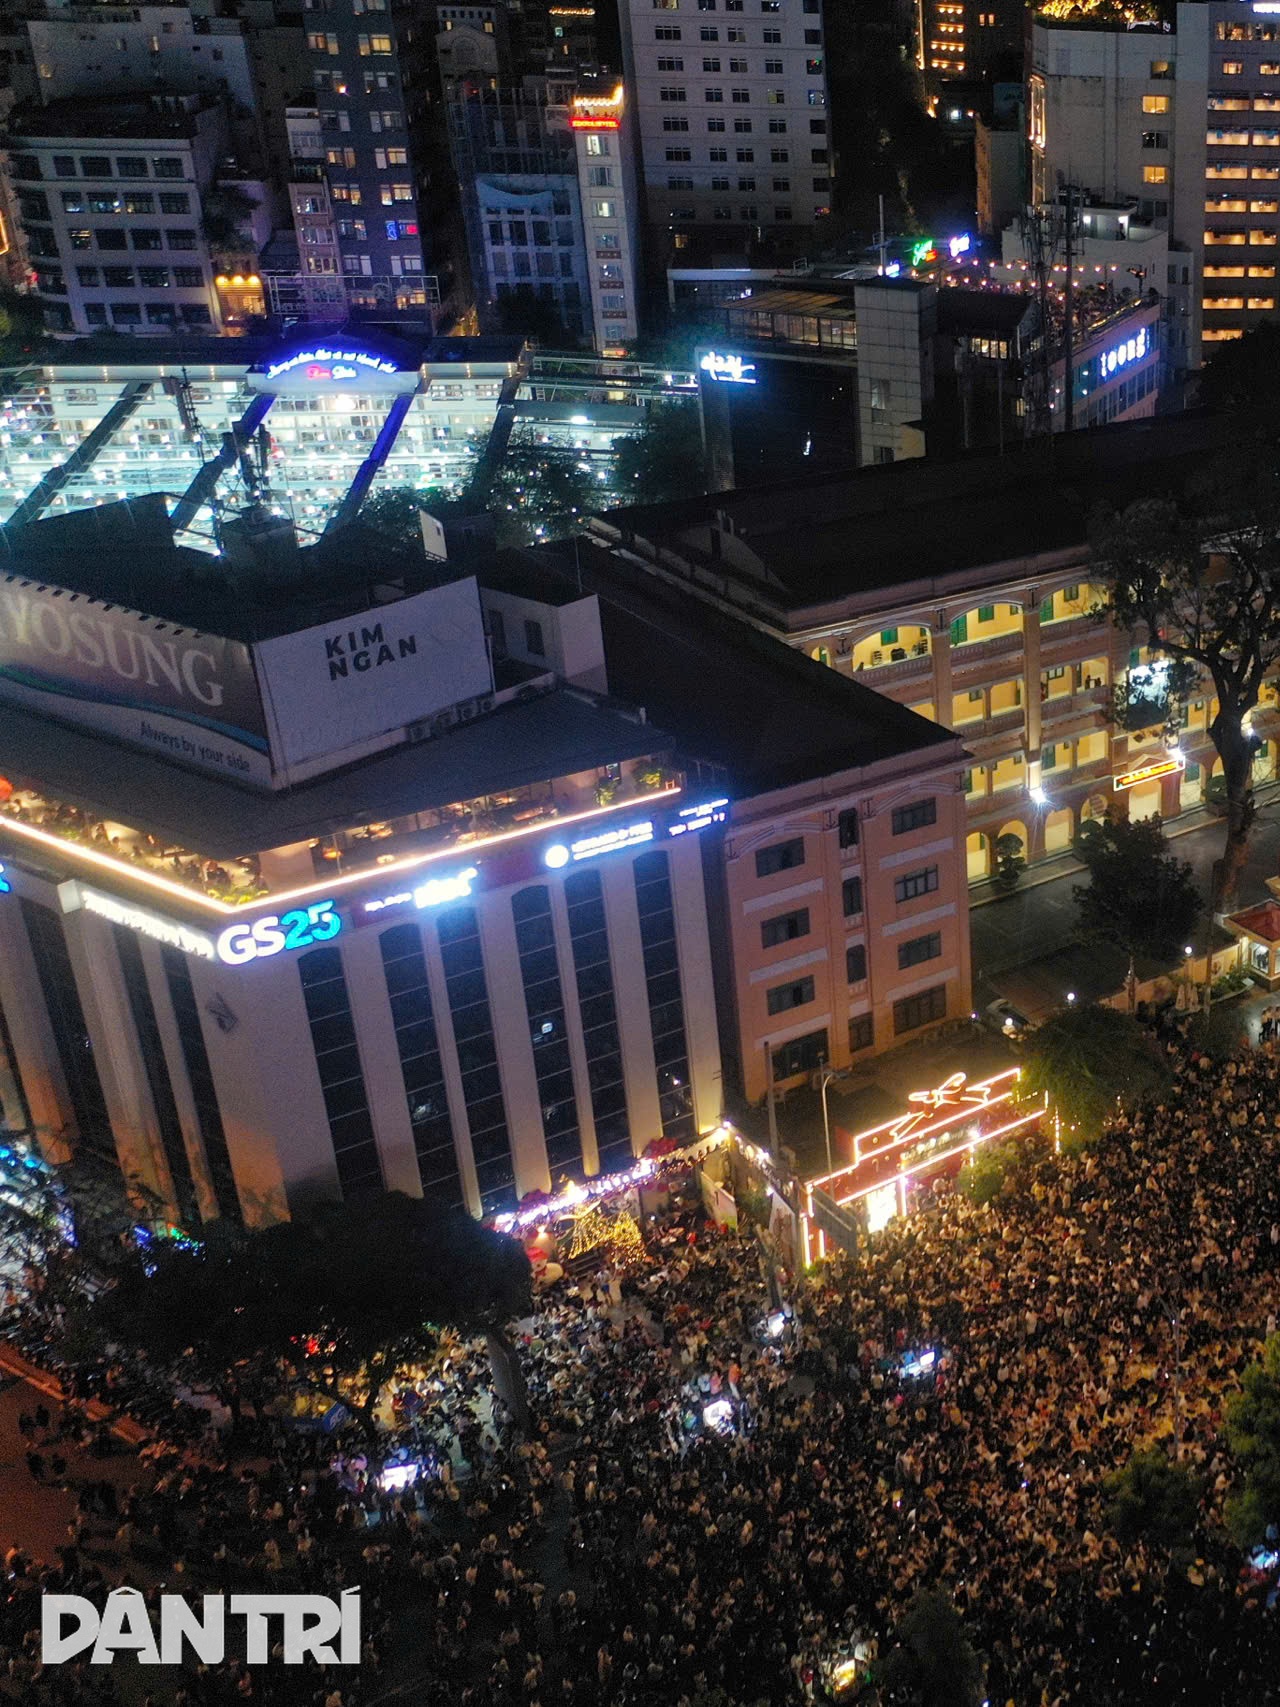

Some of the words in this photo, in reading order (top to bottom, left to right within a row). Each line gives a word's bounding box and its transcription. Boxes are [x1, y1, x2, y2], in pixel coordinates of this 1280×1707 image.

[0, 592, 223, 707] YOSUNG
[324, 622, 384, 659] KIM
[328, 634, 417, 681] NGAN
[181, 736, 195, 757] by
[217, 900, 341, 965] GS25
